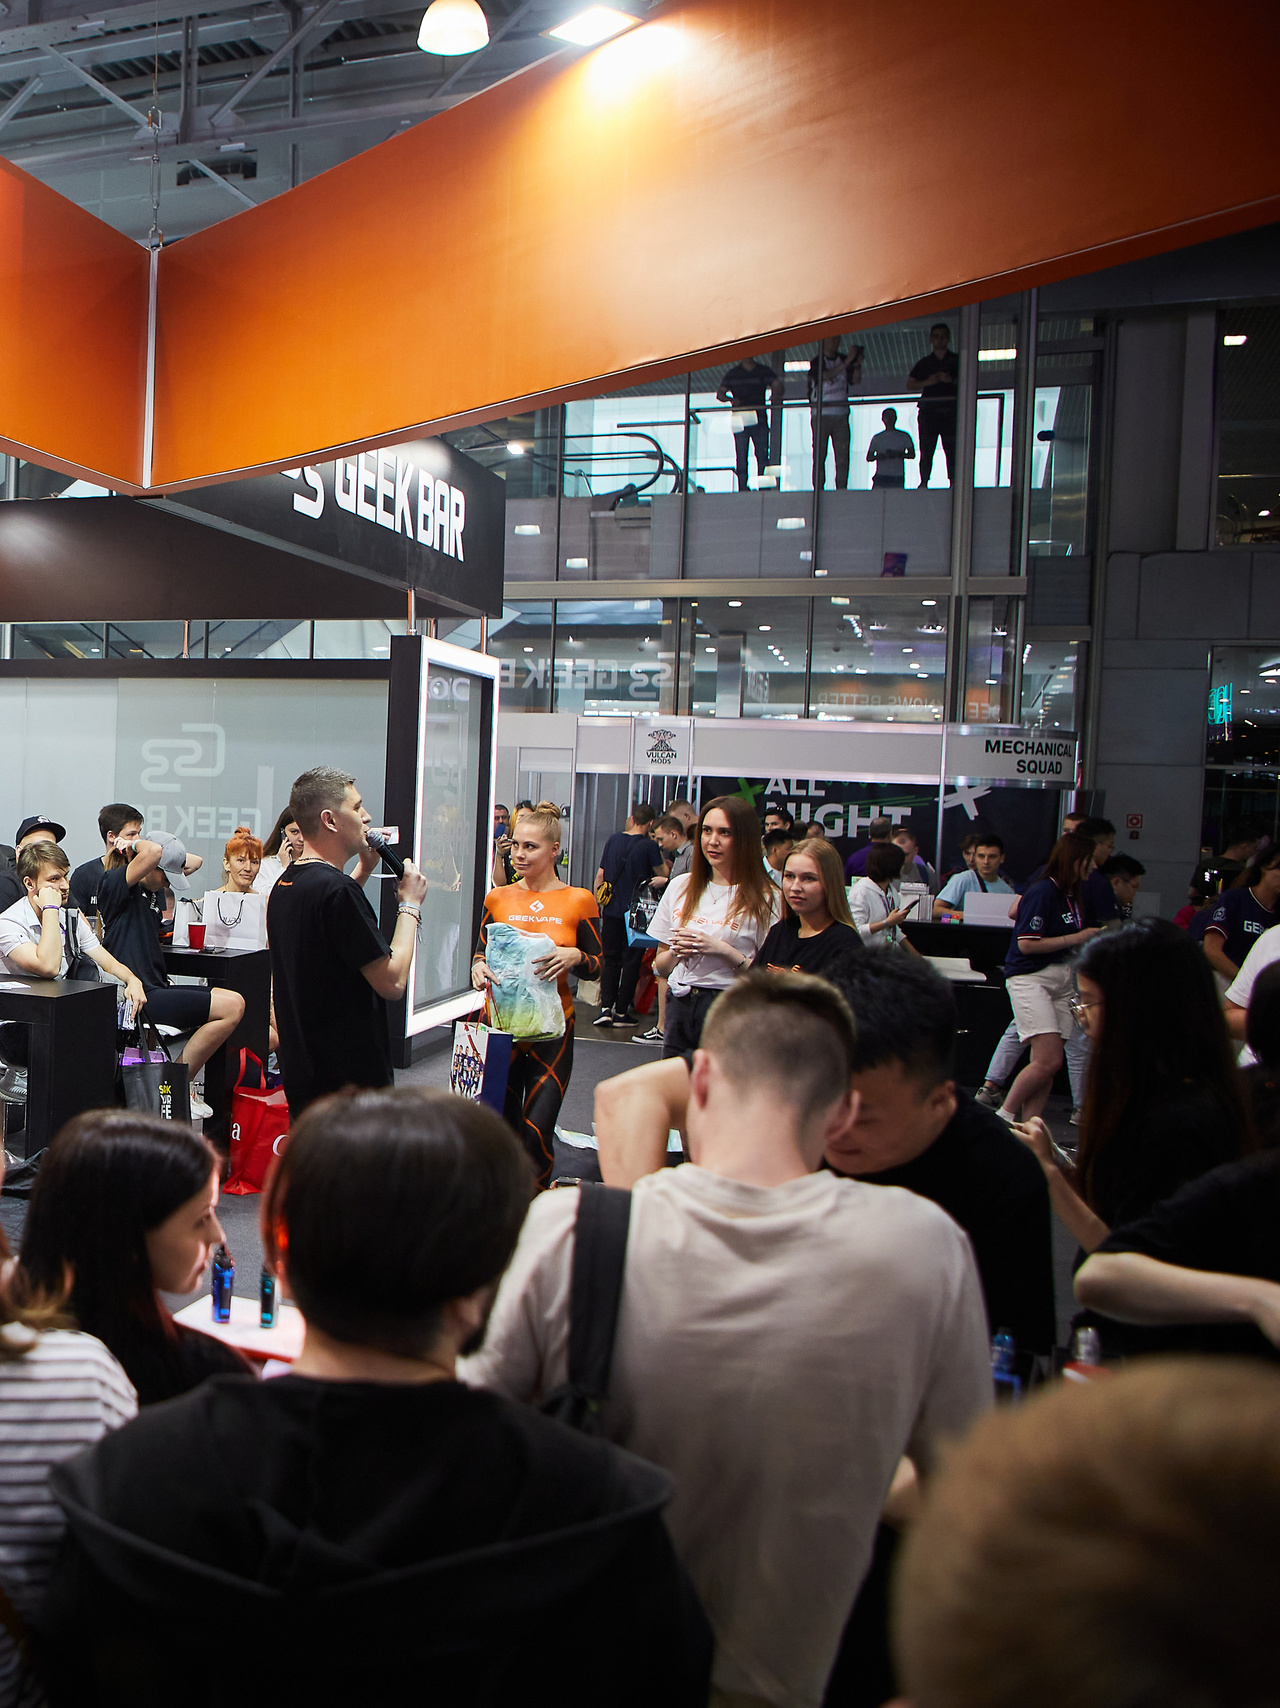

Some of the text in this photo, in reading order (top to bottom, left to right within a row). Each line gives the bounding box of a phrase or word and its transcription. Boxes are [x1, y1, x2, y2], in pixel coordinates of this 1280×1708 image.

[335, 448, 466, 563] GEEK BAR
[646, 751, 677, 759] VULCAN
[984, 739, 1072, 757] MECHANICAL
[1016, 759, 1062, 775] SQUAD
[764, 778, 826, 796] ALL
